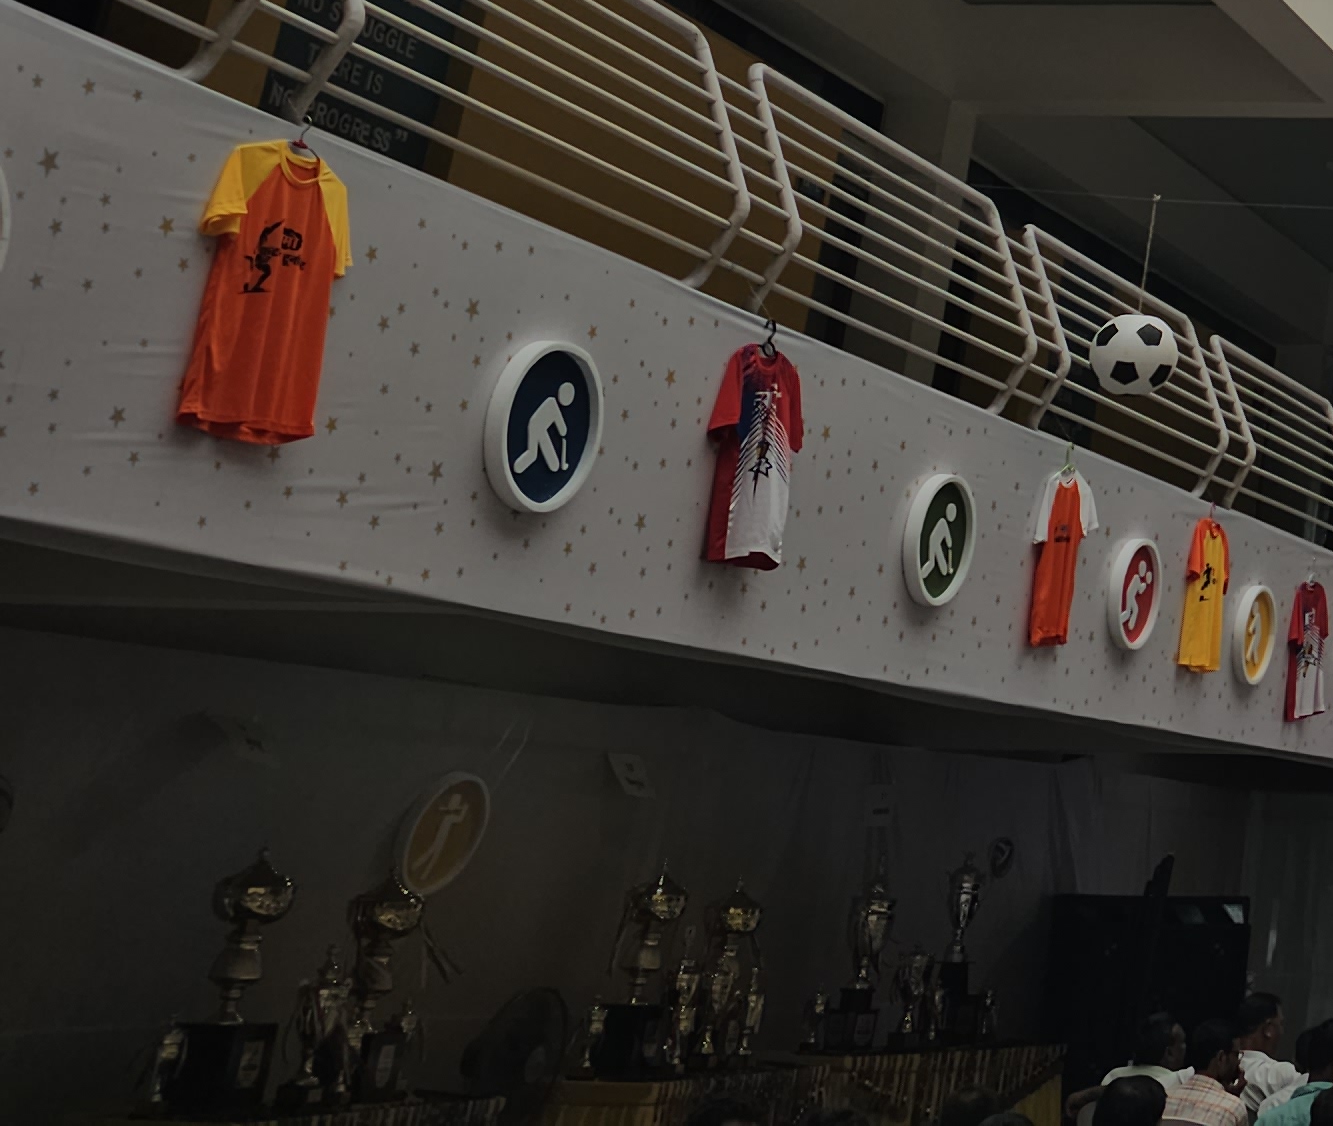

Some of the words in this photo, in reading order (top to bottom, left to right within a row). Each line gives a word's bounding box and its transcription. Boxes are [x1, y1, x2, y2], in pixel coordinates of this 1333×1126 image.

[329, 0, 418, 60] SUGGLE
[307, 42, 363, 86] TRE
[364, 69, 384, 95] IS
